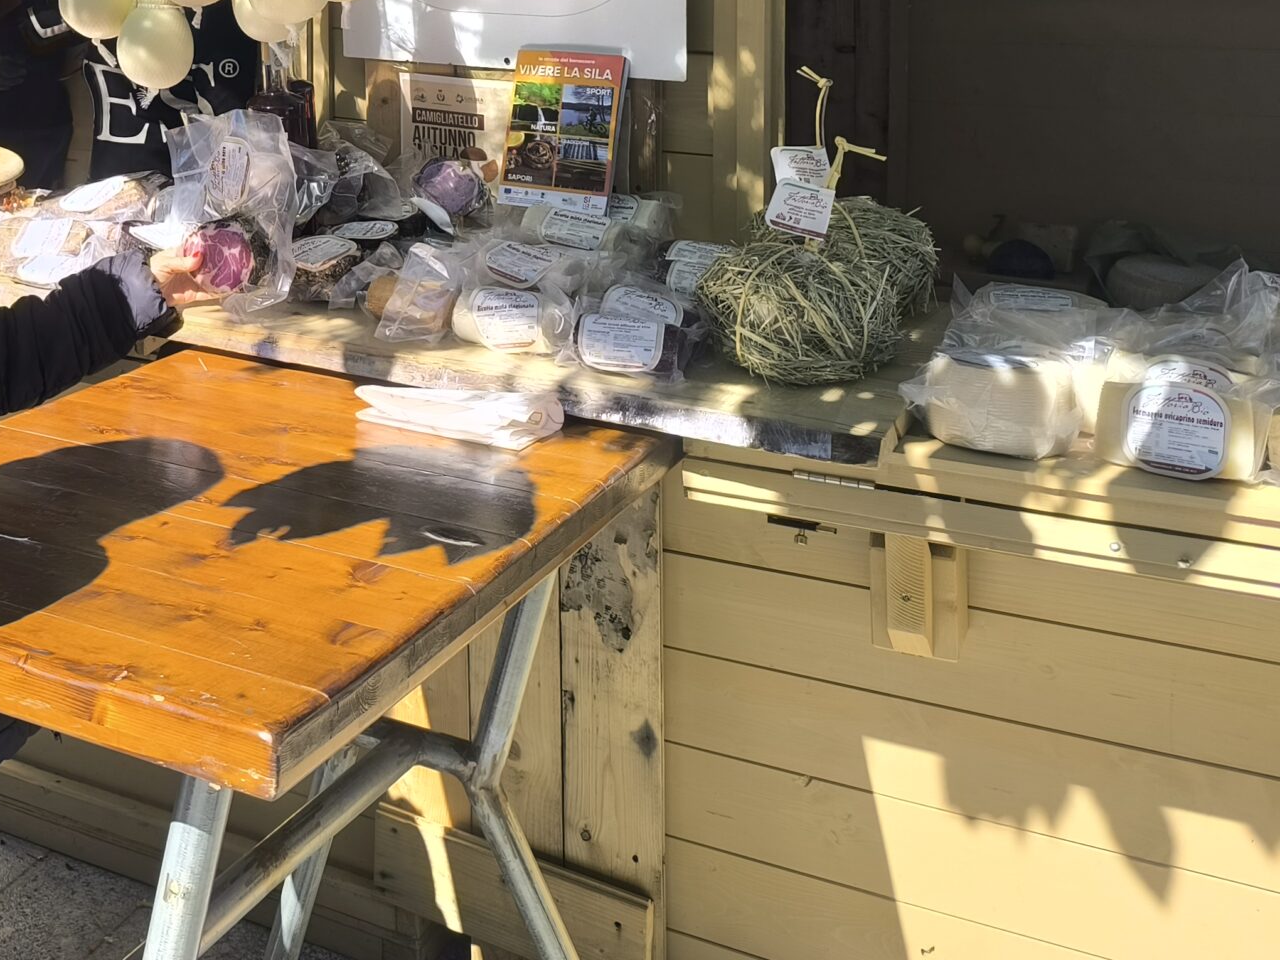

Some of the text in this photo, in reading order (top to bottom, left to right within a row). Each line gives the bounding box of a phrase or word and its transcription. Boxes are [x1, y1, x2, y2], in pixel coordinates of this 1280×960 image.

[519, 64, 613, 81] VIVERE LA SILA
[586, 88, 611, 96] SPORT
[415, 110, 479, 128] CAMIGLIATELLO
[412, 125, 476, 148] AUTUNNO
[530, 124, 556, 132] NATURA
[507, 173, 533, 182] SAPORI
[1132, 406, 1224, 428] Formaggio ovicaprino semiduro
